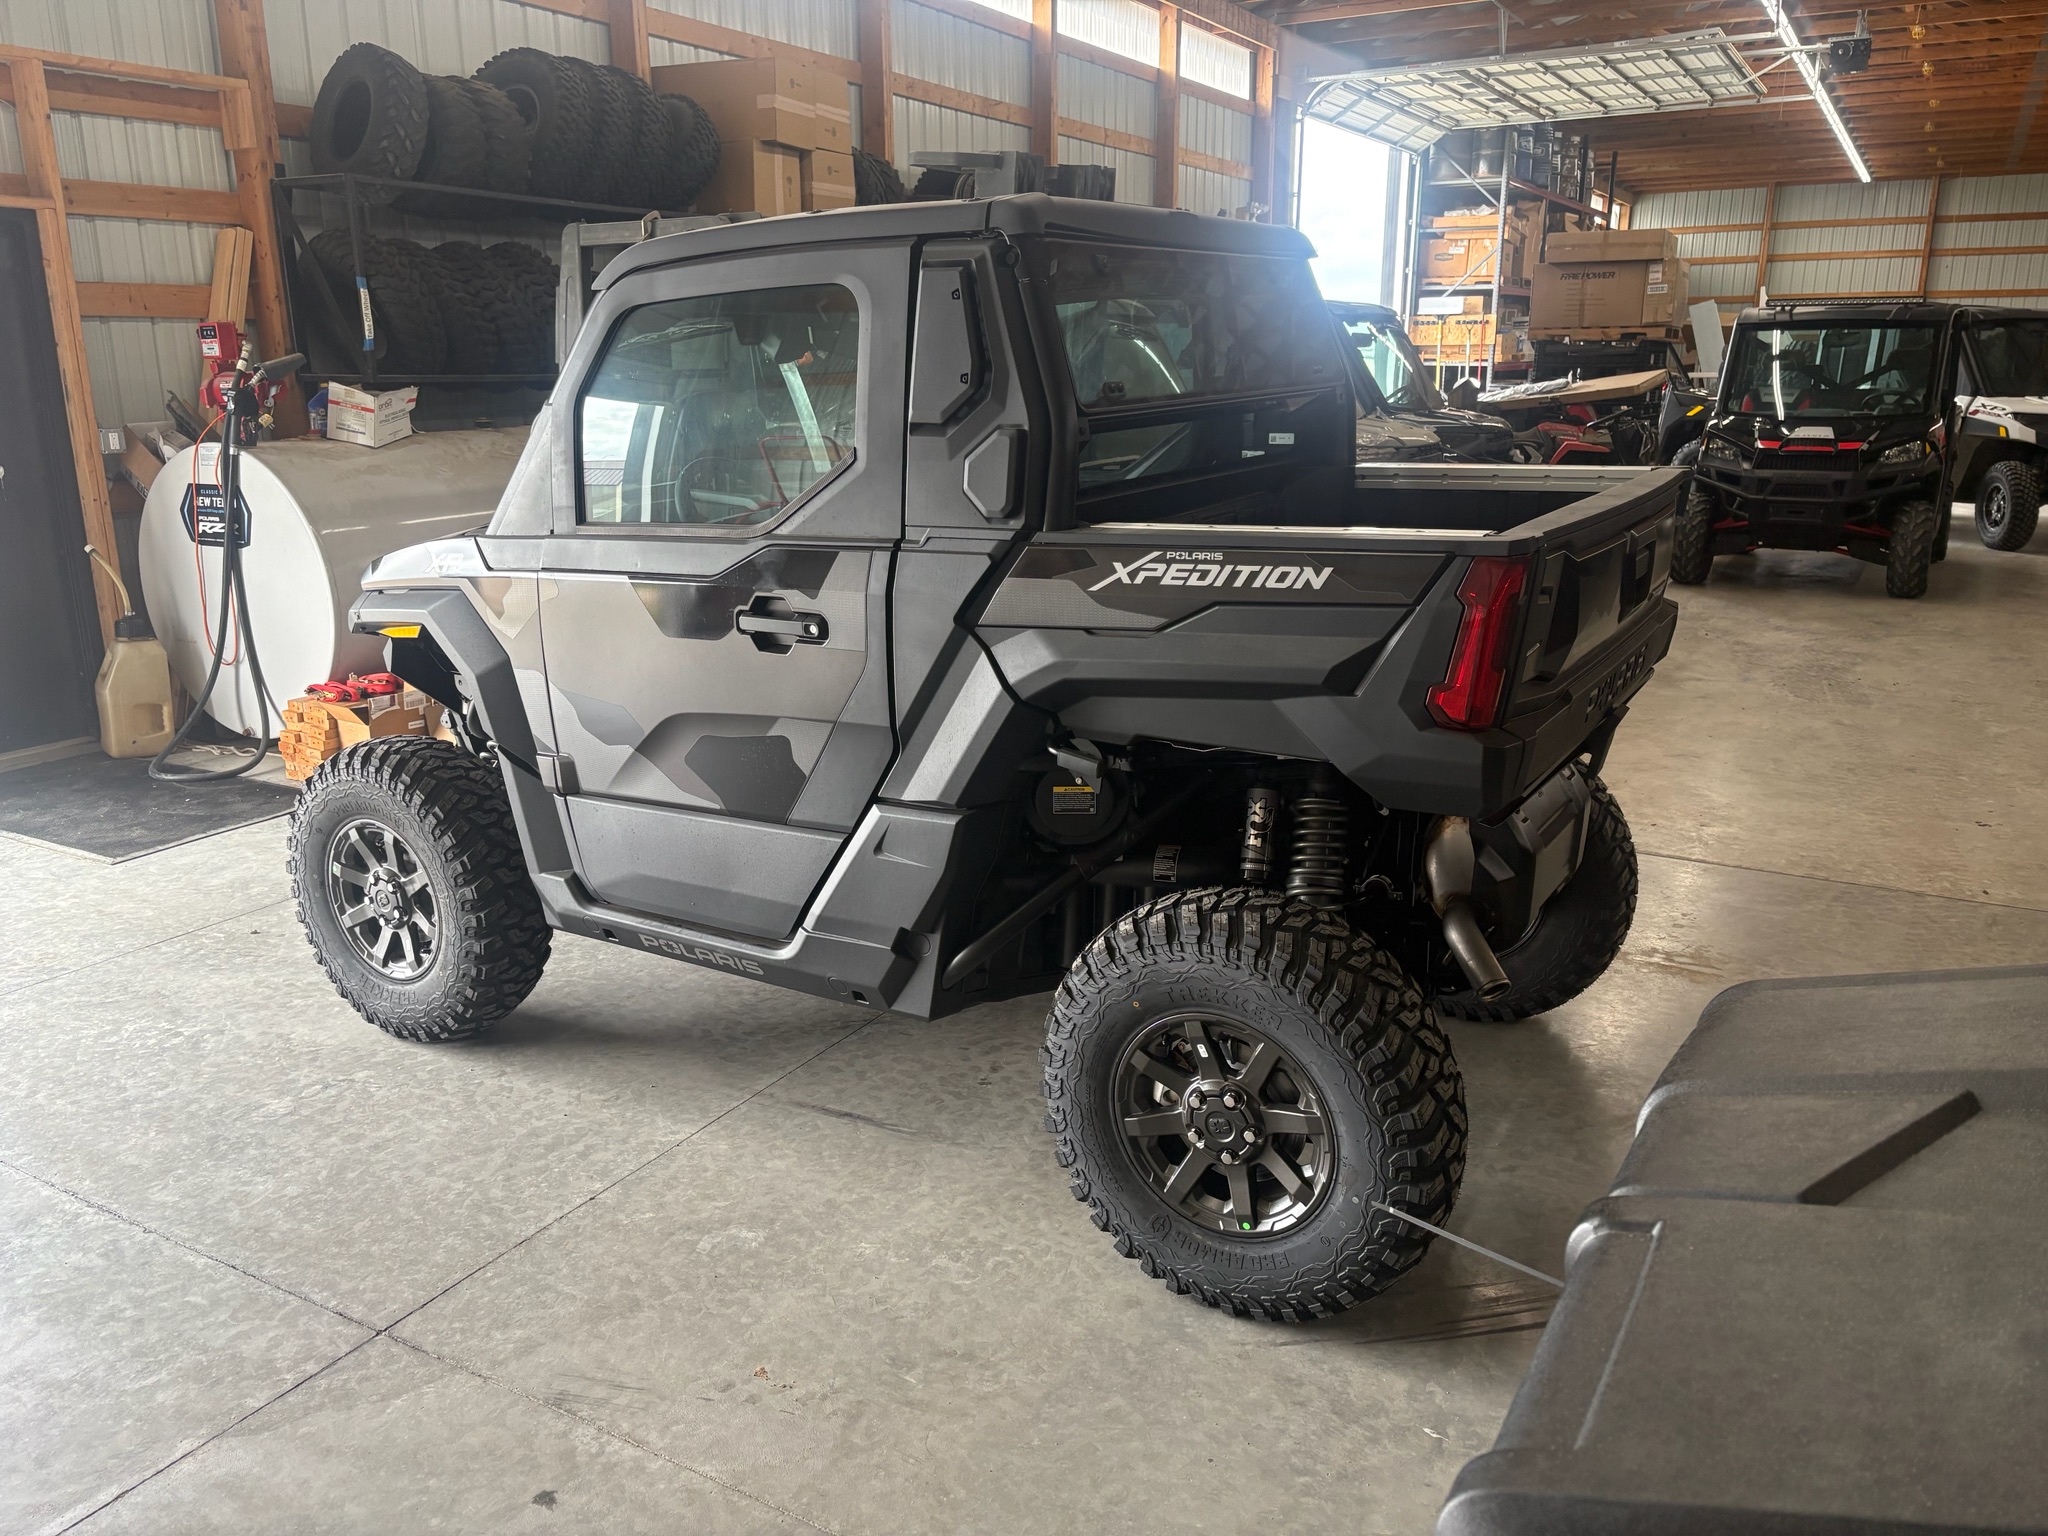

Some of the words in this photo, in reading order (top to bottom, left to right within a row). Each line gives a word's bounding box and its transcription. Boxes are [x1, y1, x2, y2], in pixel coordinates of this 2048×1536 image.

[364, 312, 372, 322] Off
[366, 323, 374, 339] Take
[1086, 551, 1335, 591] XPEDITION
[1166, 551, 1224, 561] POLARIS
[1244, 798, 1275, 848] FOX
[638, 933, 765, 975] POLARIS
[1161, 984, 1283, 1032] TREKKER
